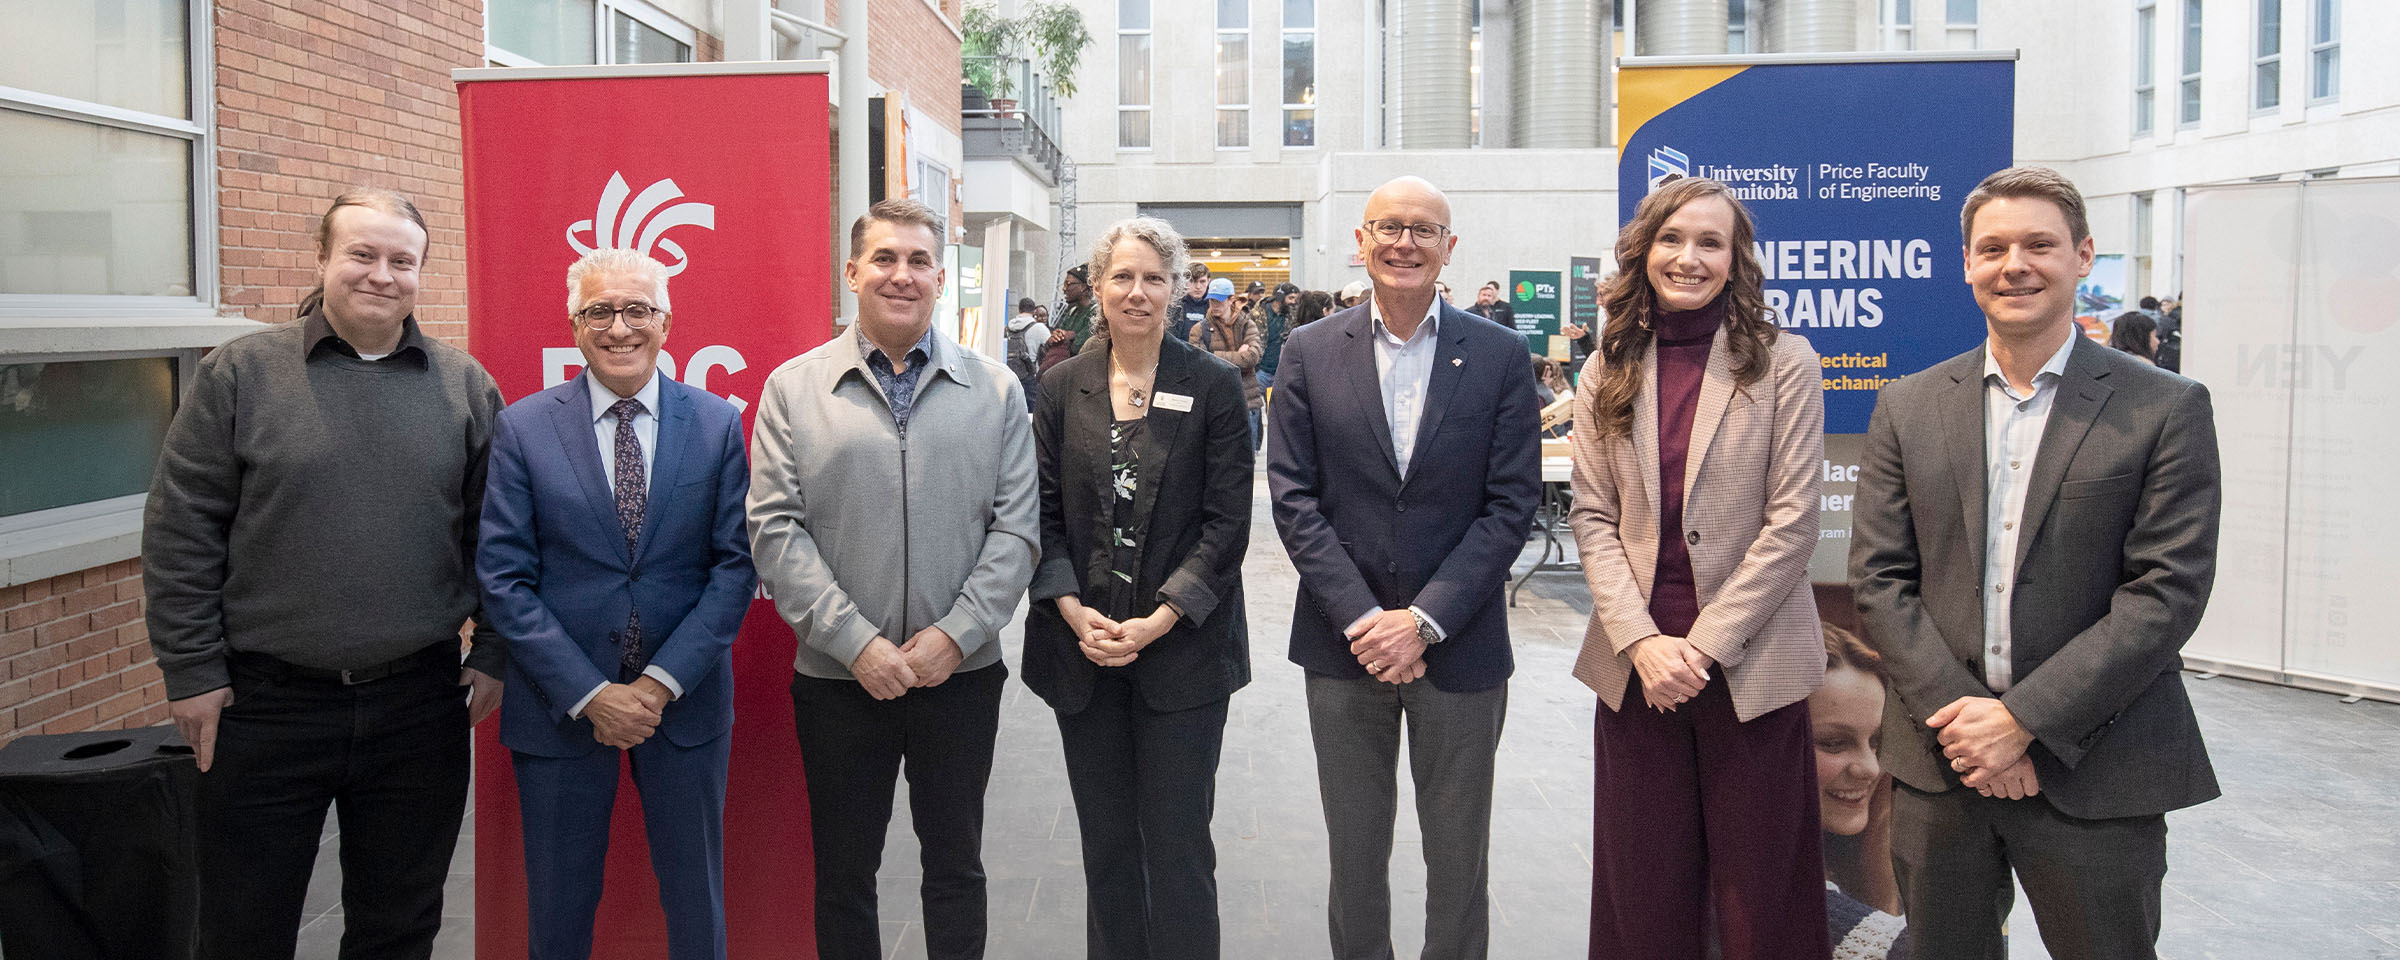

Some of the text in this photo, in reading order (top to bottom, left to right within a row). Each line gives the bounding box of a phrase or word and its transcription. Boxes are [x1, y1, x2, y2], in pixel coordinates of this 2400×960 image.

[1698, 164, 1799, 184] University
[1819, 162, 1929, 182] Price Faculty
[1819, 182, 1941, 202] of Engineering
[1536, 284, 1555, 293] PTx
[1763, 287, 1884, 328] RAMS
[1822, 374, 1905, 391] echanic
